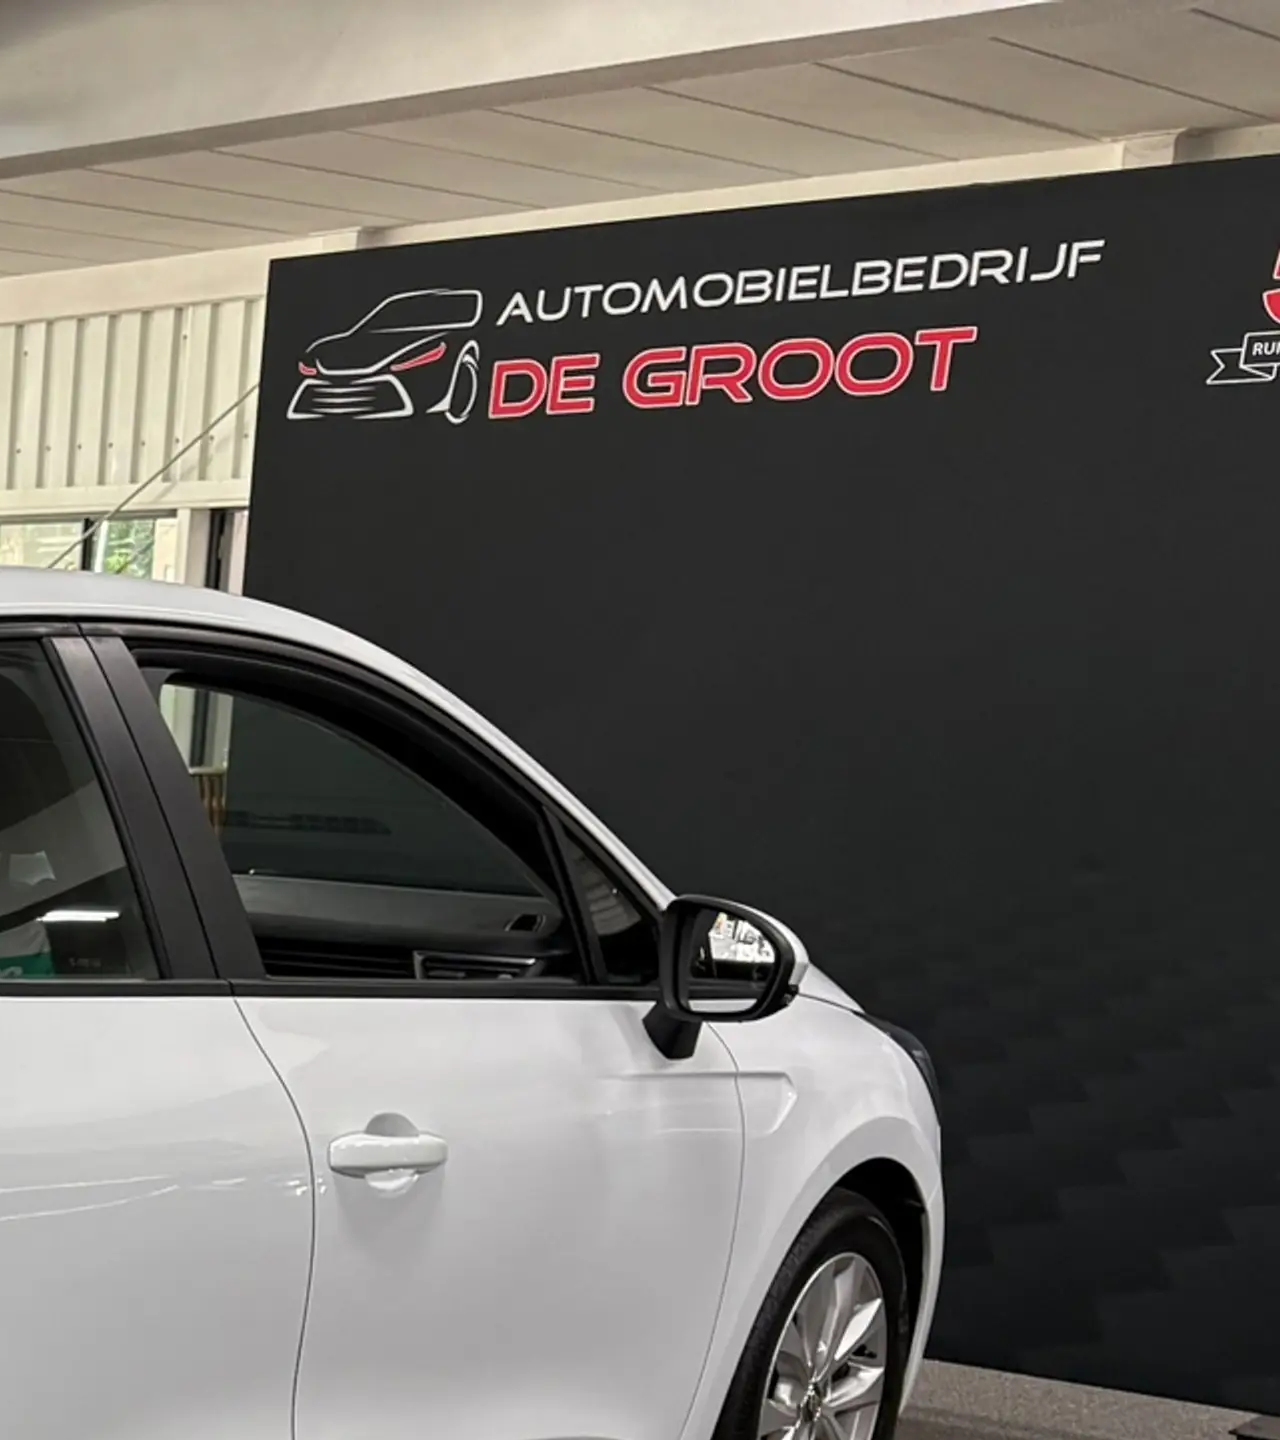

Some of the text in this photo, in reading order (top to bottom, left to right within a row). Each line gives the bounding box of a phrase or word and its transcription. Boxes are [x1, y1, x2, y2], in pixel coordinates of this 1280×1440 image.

[496, 239, 1106, 326] AUTOMOBIELBEDRIJF
[487, 325, 978, 420] DE GROOT
